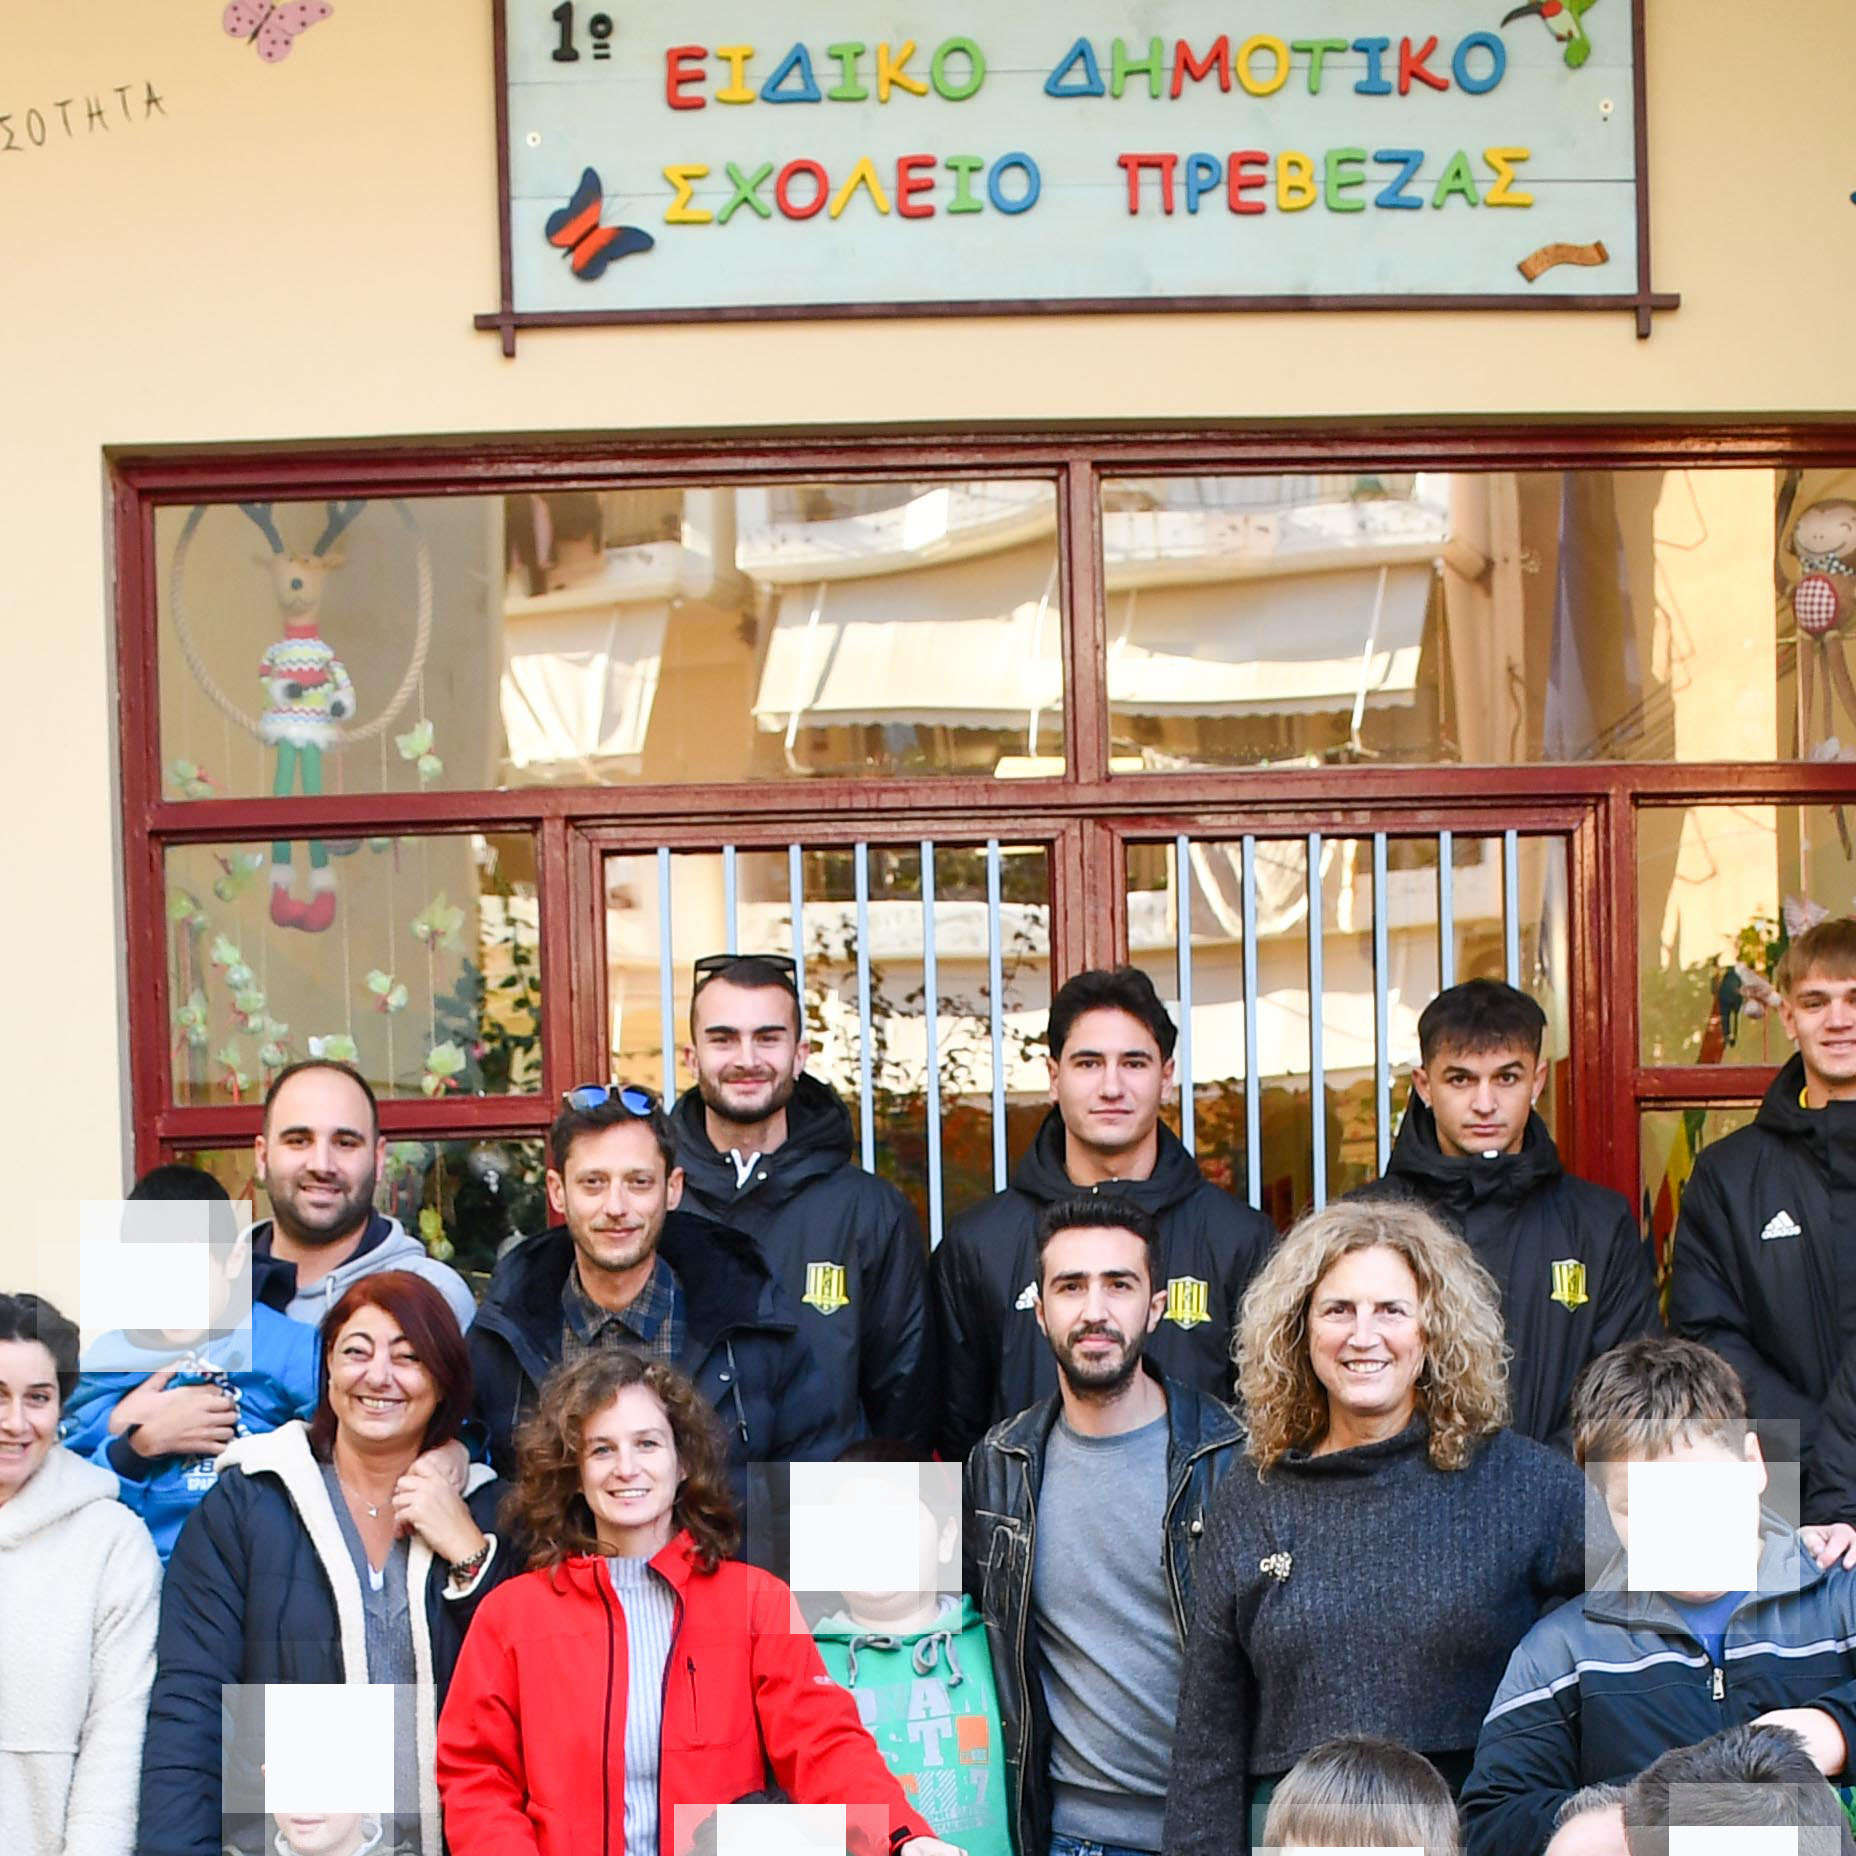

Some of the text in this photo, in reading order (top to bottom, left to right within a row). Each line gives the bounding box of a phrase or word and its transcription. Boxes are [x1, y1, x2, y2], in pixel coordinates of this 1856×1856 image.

[666, 37, 985, 110] ΕΙΔΙΚΟ
[1045, 31, 1507, 99] ΔΗΜΟΤΙΚΟ
[663, 147, 1534, 224] ΣΧΟΛΕΙΟ ΠΡΕΒΕΖΑΣ
